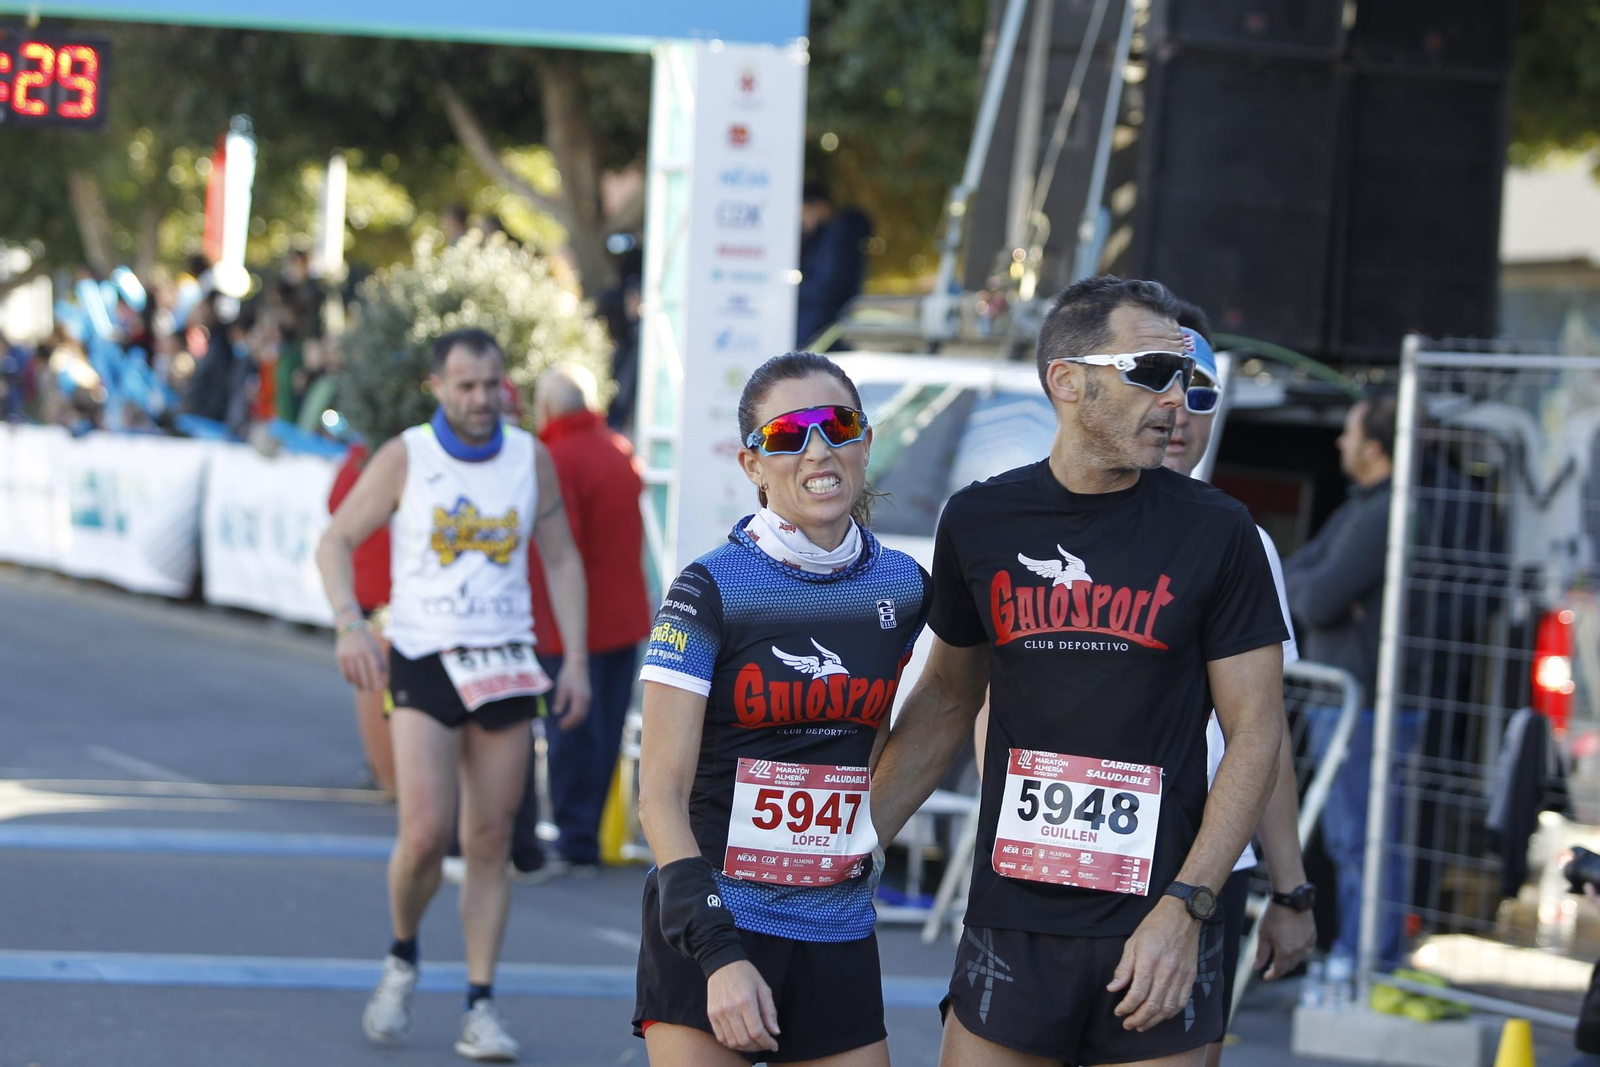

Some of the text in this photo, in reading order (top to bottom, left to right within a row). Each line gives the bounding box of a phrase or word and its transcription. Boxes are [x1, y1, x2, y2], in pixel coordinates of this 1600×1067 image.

[673, 601, 698, 616] pujalte
[1024, 639, 1129, 652] CLUB DEPORTIVO
[805, 727, 858, 736] DEPORTIVO
[1034, 757, 1069, 767] MARATÓN
[1101, 758, 1151, 774] CARRERA
[775, 766, 810, 775] MARATÓN
[1034, 764, 1064, 774] ALMERÍA
[774, 773, 806, 782] ALMERÍA
[823, 774, 867, 784] SALUDABLE
[1085, 768, 1151, 786] SALUDABLE
[751, 787, 862, 835] 5947
[1017, 778, 1140, 835] 5948
[791, 832, 831, 847] LÓPEZ
[1040, 825, 1098, 843] GUILLEN
[736, 852, 814, 865] NEXA CDX ALMERÍA
[1002, 845, 1019, 855] NEXA
[1048, 850, 1072, 859] ALMERÍA
[734, 869, 756, 878] Blanes
